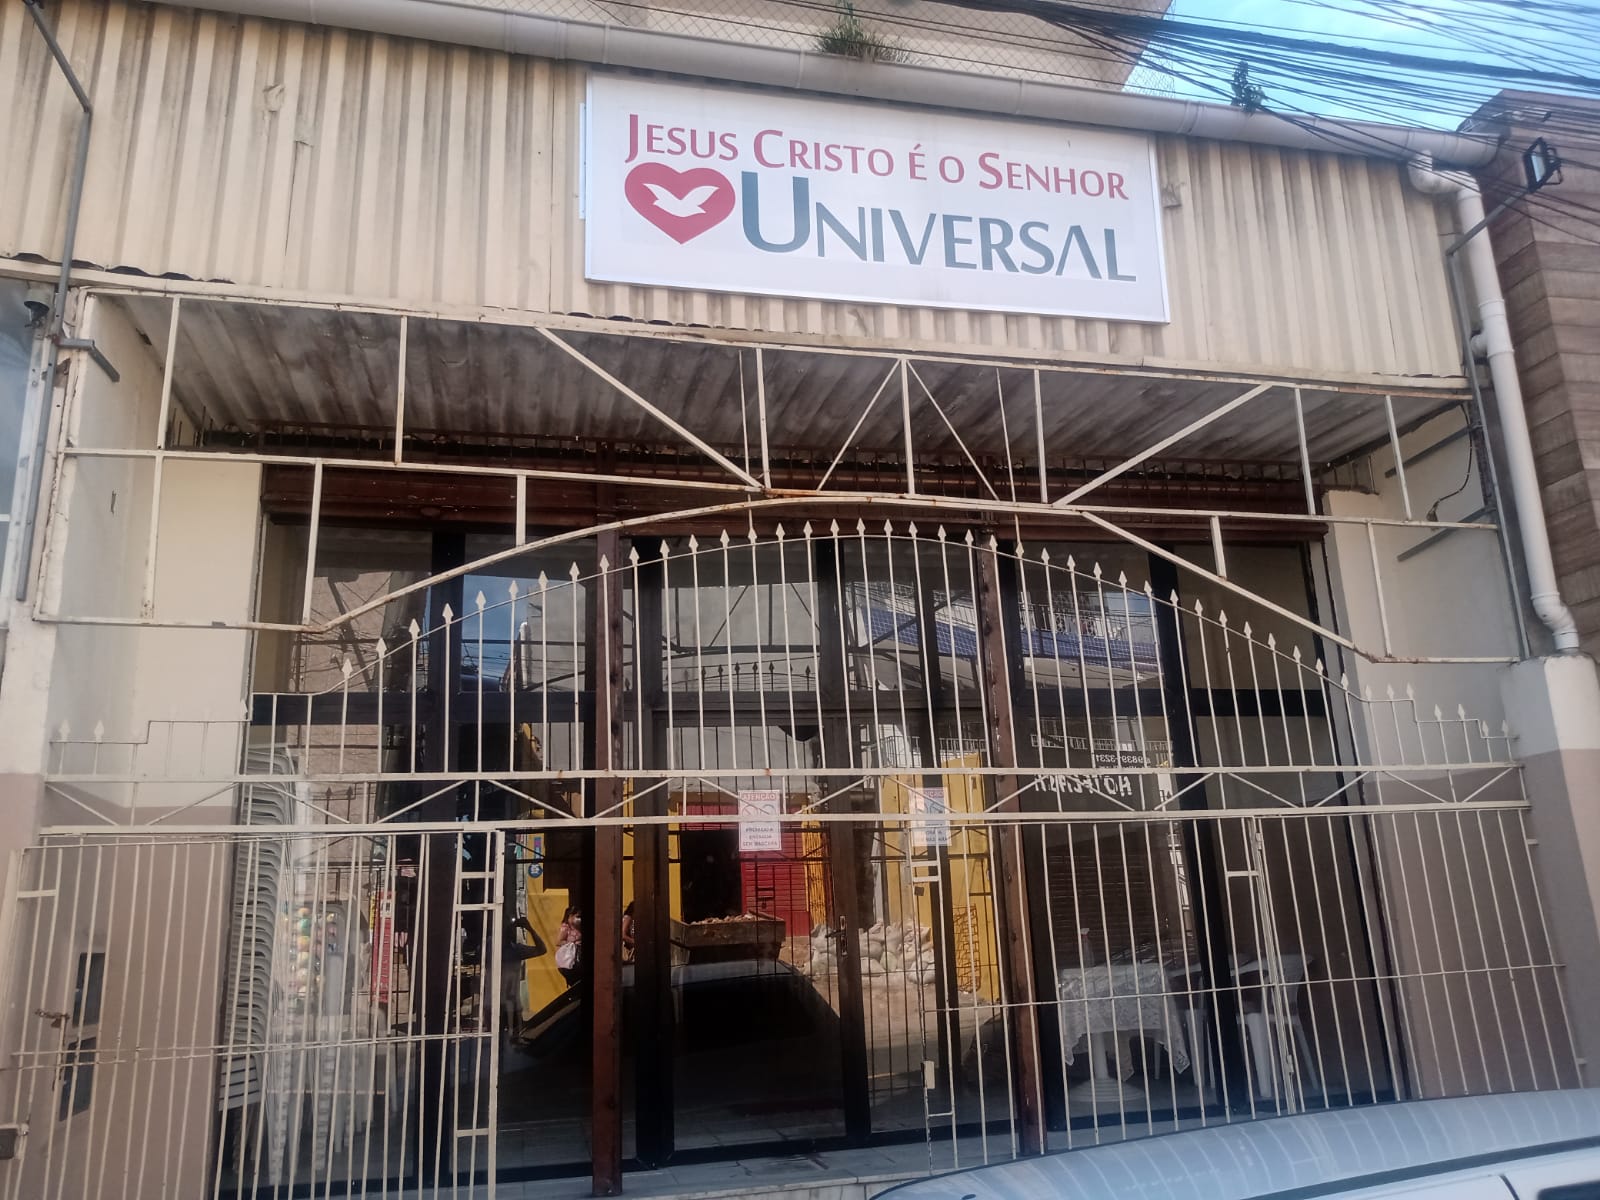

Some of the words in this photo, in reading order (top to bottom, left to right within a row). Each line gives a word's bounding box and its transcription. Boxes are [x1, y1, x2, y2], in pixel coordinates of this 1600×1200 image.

[625, 113, 739, 163] JESUS
[753, 129, 894, 177] CRISTO
[908, 143, 928, 181] É
[939, 155, 965, 184] O
[978, 152, 1129, 201] SENHOR
[741, 170, 1137, 282] UNIVERSAL
